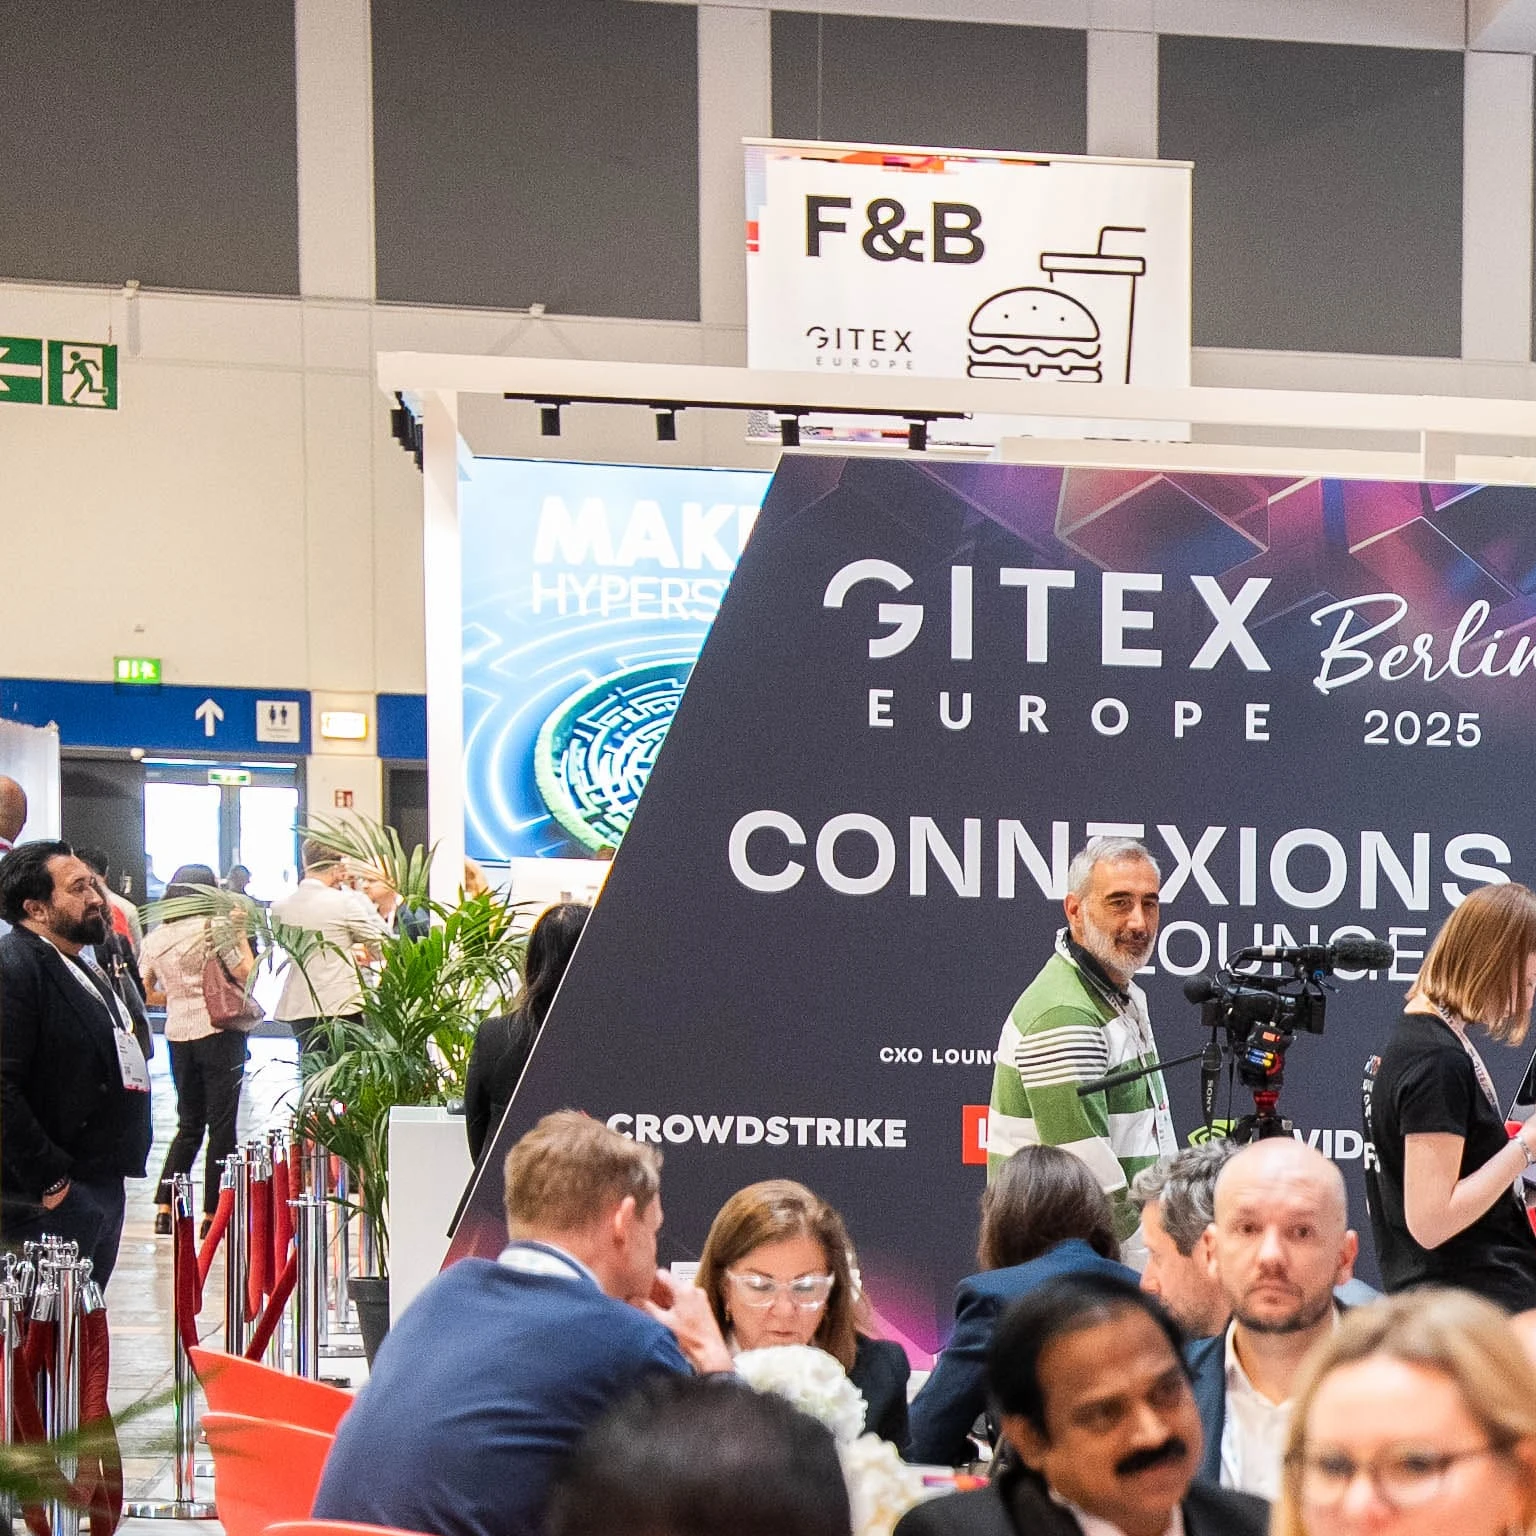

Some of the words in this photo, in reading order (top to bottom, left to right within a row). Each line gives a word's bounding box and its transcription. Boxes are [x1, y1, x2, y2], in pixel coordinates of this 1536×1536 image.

[805, 194, 985, 263] F&B
[806, 326, 912, 353] GITEX
[816, 356, 914, 370] EUROPE
[823, 558, 1272, 673] GITEX
[868, 689, 1270, 741] EUROPE
[1363, 710, 1483, 748] 2025
[880, 1047, 923, 1063] CXO
[1206, 1080, 1214, 1112] SONY
[606, 1113, 907, 1148] CROWDSTRIKE
